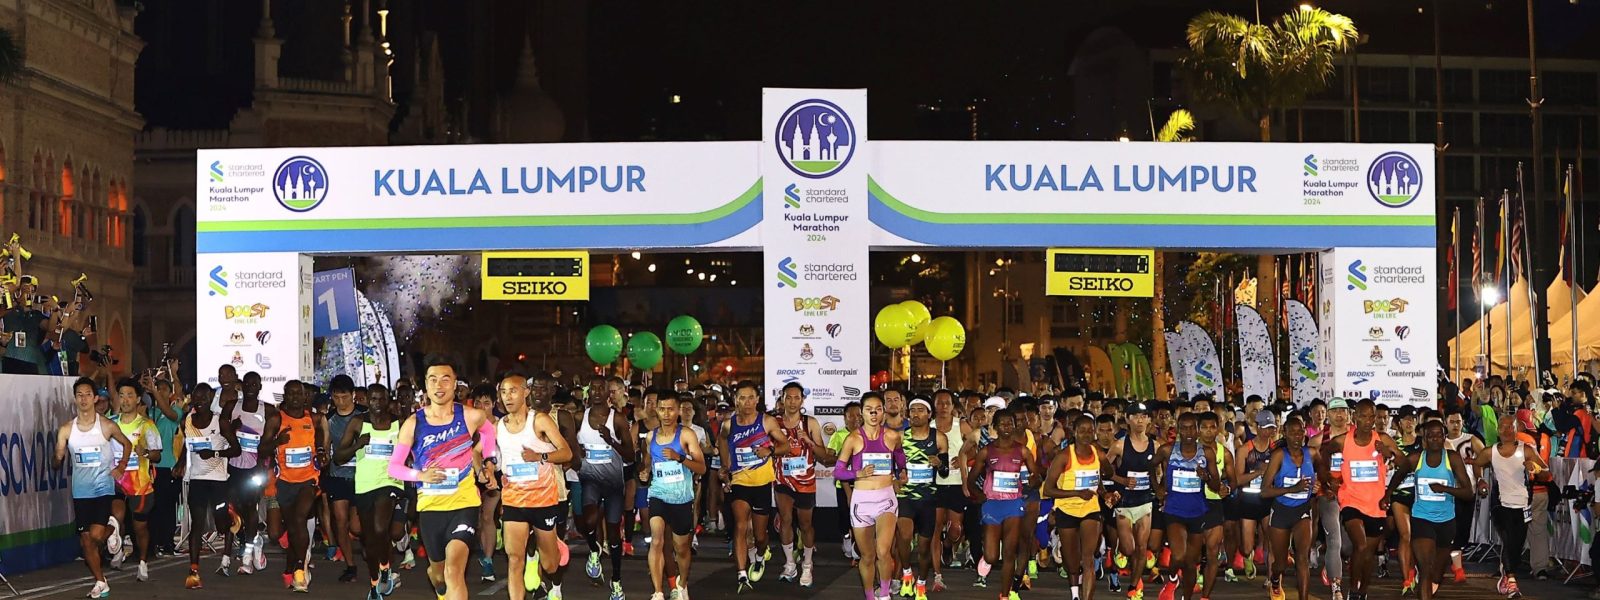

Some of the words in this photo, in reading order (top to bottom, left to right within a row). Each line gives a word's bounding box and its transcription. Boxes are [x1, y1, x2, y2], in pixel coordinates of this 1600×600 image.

[374, 168, 492, 196] KUALA
[501, 165, 646, 194] LUMPUR
[985, 164, 1104, 191] KUALA
[1113, 164, 1257, 193] LUMPUR
[1303, 180, 1327, 188] Kuala
[1328, 180, 1358, 189] Lumpur
[234, 186, 264, 195] Lumpur
[805, 188, 846, 196] standard
[805, 196, 849, 204] chartered
[784, 213, 811, 222] Kuala
[813, 213, 849, 224] Lumpur
[793, 224, 840, 232] Marathon
[807, 234, 827, 242] 2024
[804, 263, 854, 272] standard
[1373, 266, 1422, 274] standard
[234, 270, 283, 280] standard
[313, 274, 330, 284] ART
[332, 272, 348, 280] PEN
[804, 272, 857, 281] chartered
[1373, 274, 1425, 284] chartered
[234, 280, 286, 288] chartered
[502, 281, 567, 295] SEIKO
[1069, 276, 1134, 292] SEIKO
[793, 295, 840, 312] BOOST
[1363, 298, 1408, 314] BOOST
[224, 302, 270, 320] BOOST
[318, 287, 339, 330] 1
[818, 368, 858, 377] Counterpain
[1388, 370, 1426, 378] Counterpain
[664, 468, 682, 476] 14268
